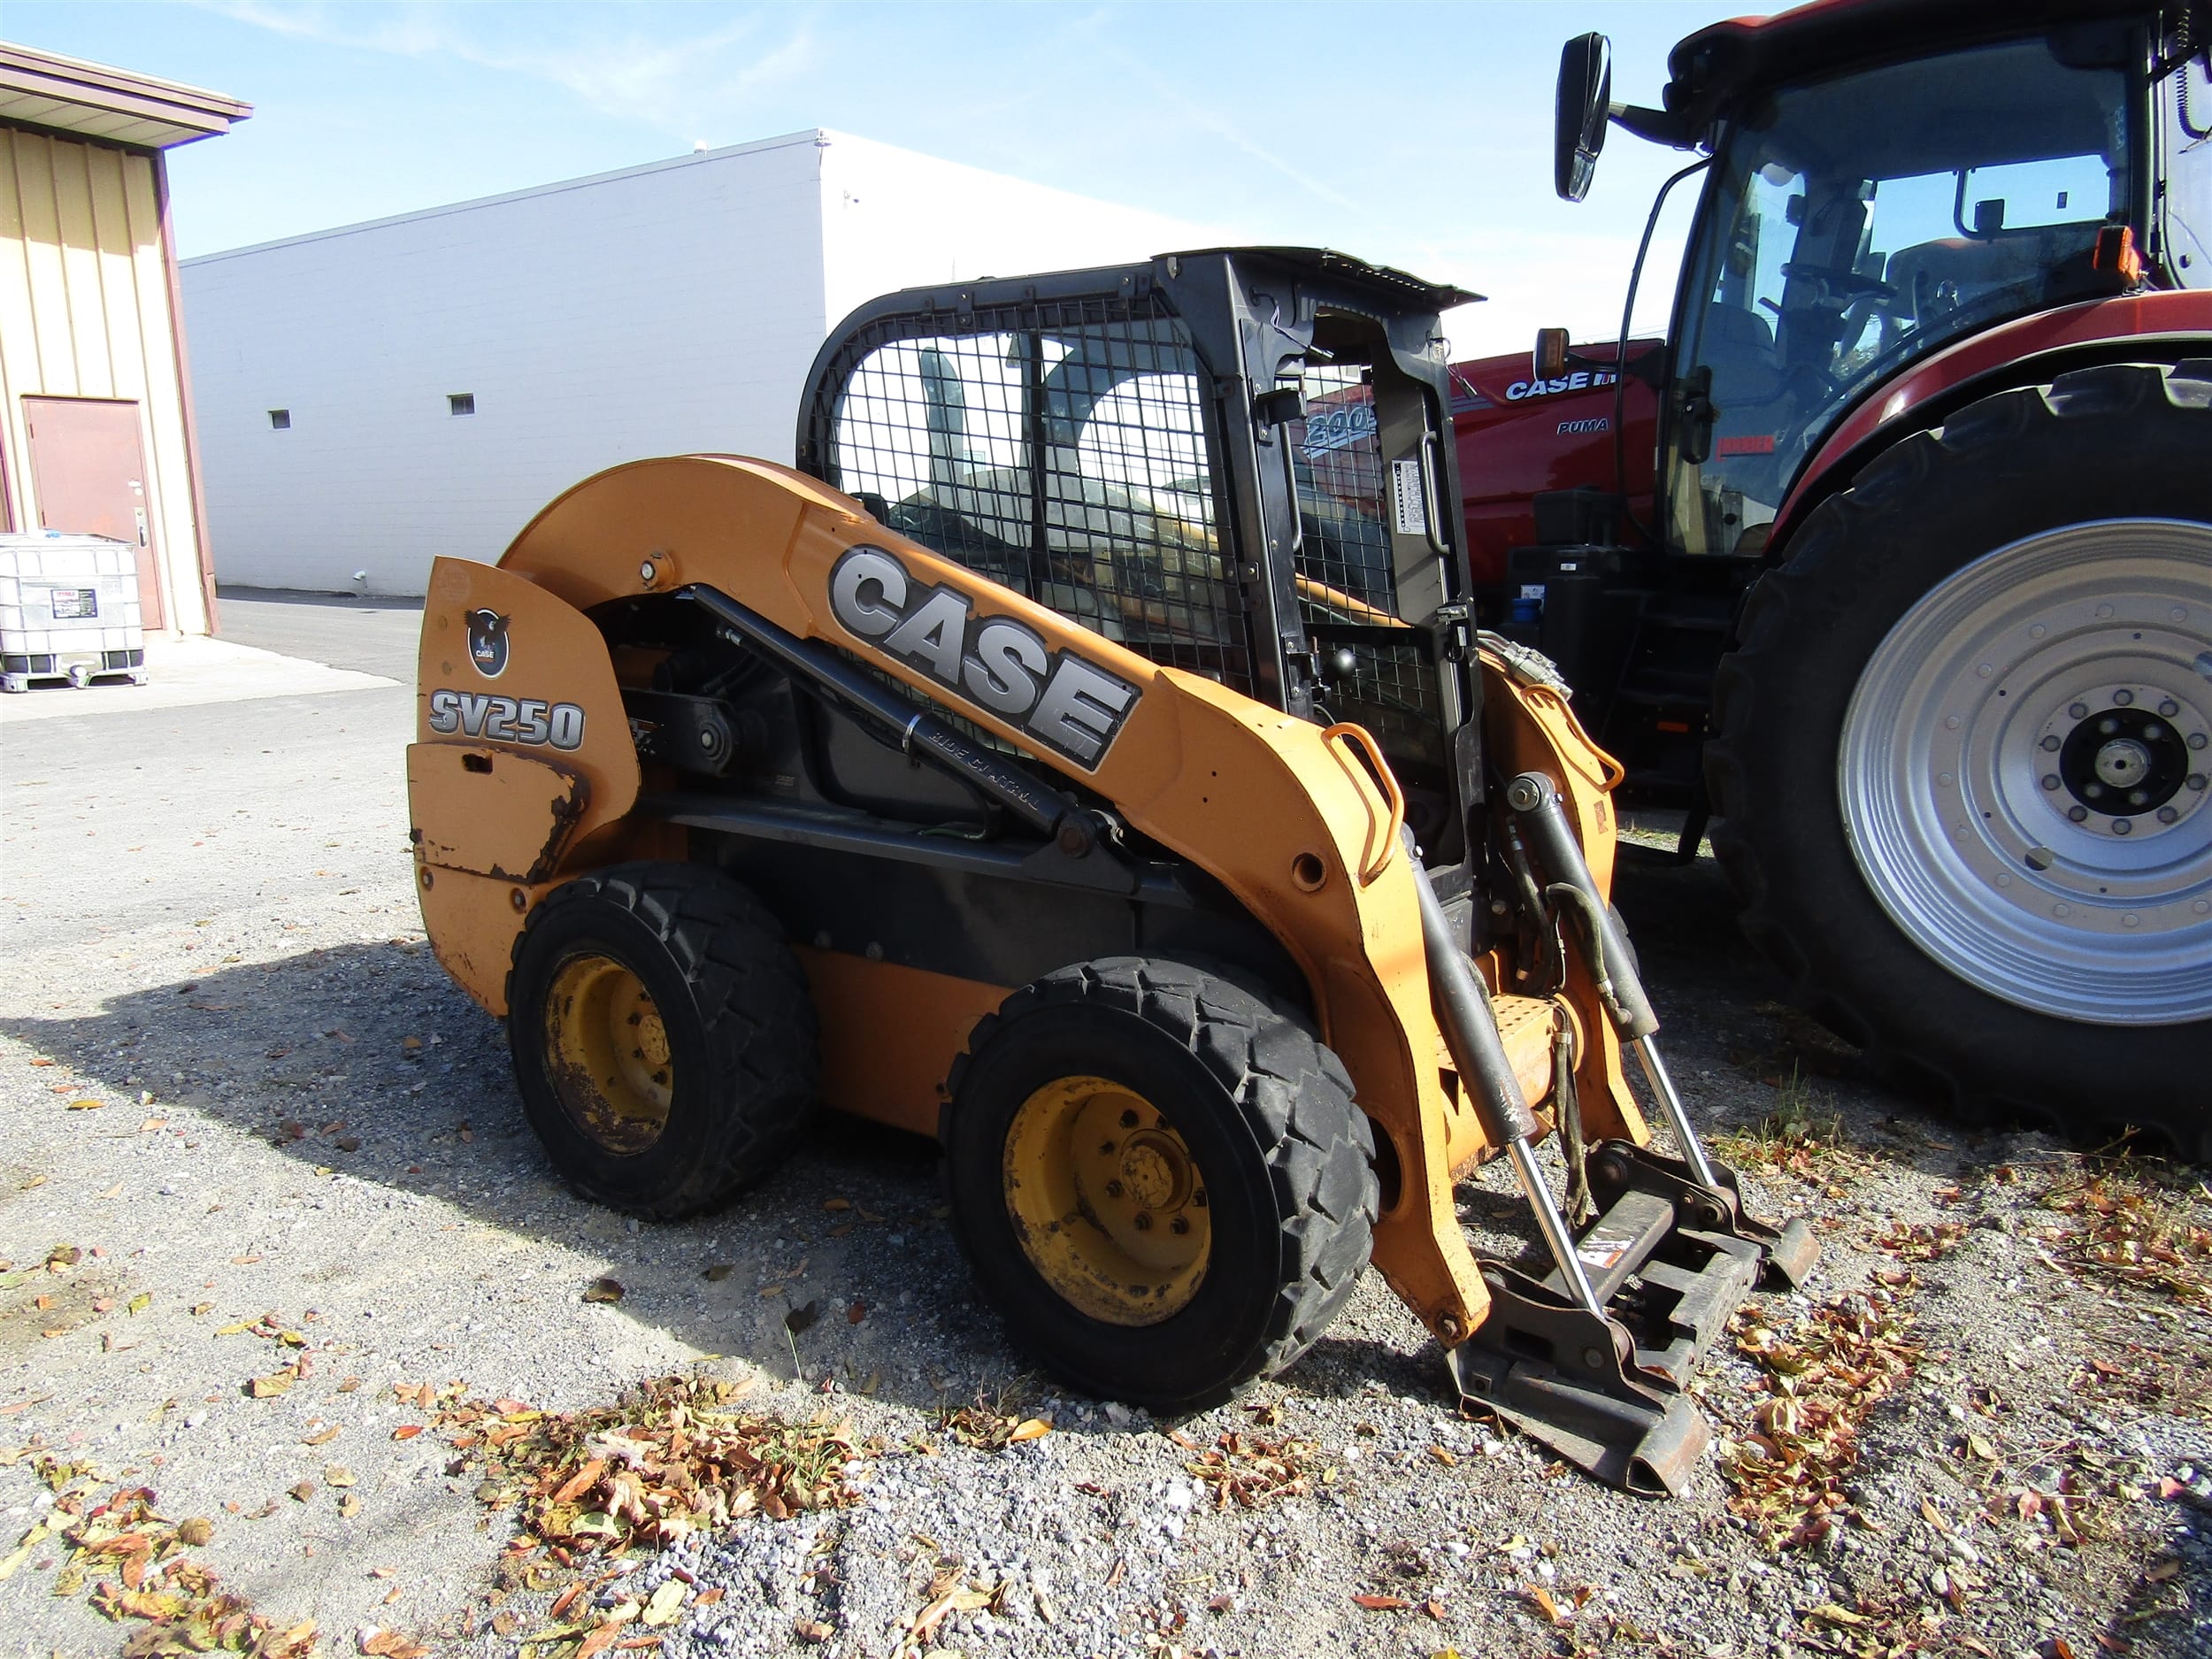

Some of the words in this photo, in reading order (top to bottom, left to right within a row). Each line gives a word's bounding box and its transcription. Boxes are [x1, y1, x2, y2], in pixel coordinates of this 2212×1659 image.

[1505, 372, 1590, 401] CASE
[1556, 418, 1609, 435] PUMA
[475, 649, 495, 659] CASE
[830, 547, 1138, 768] CASE
[429, 689, 585, 751] SV250
